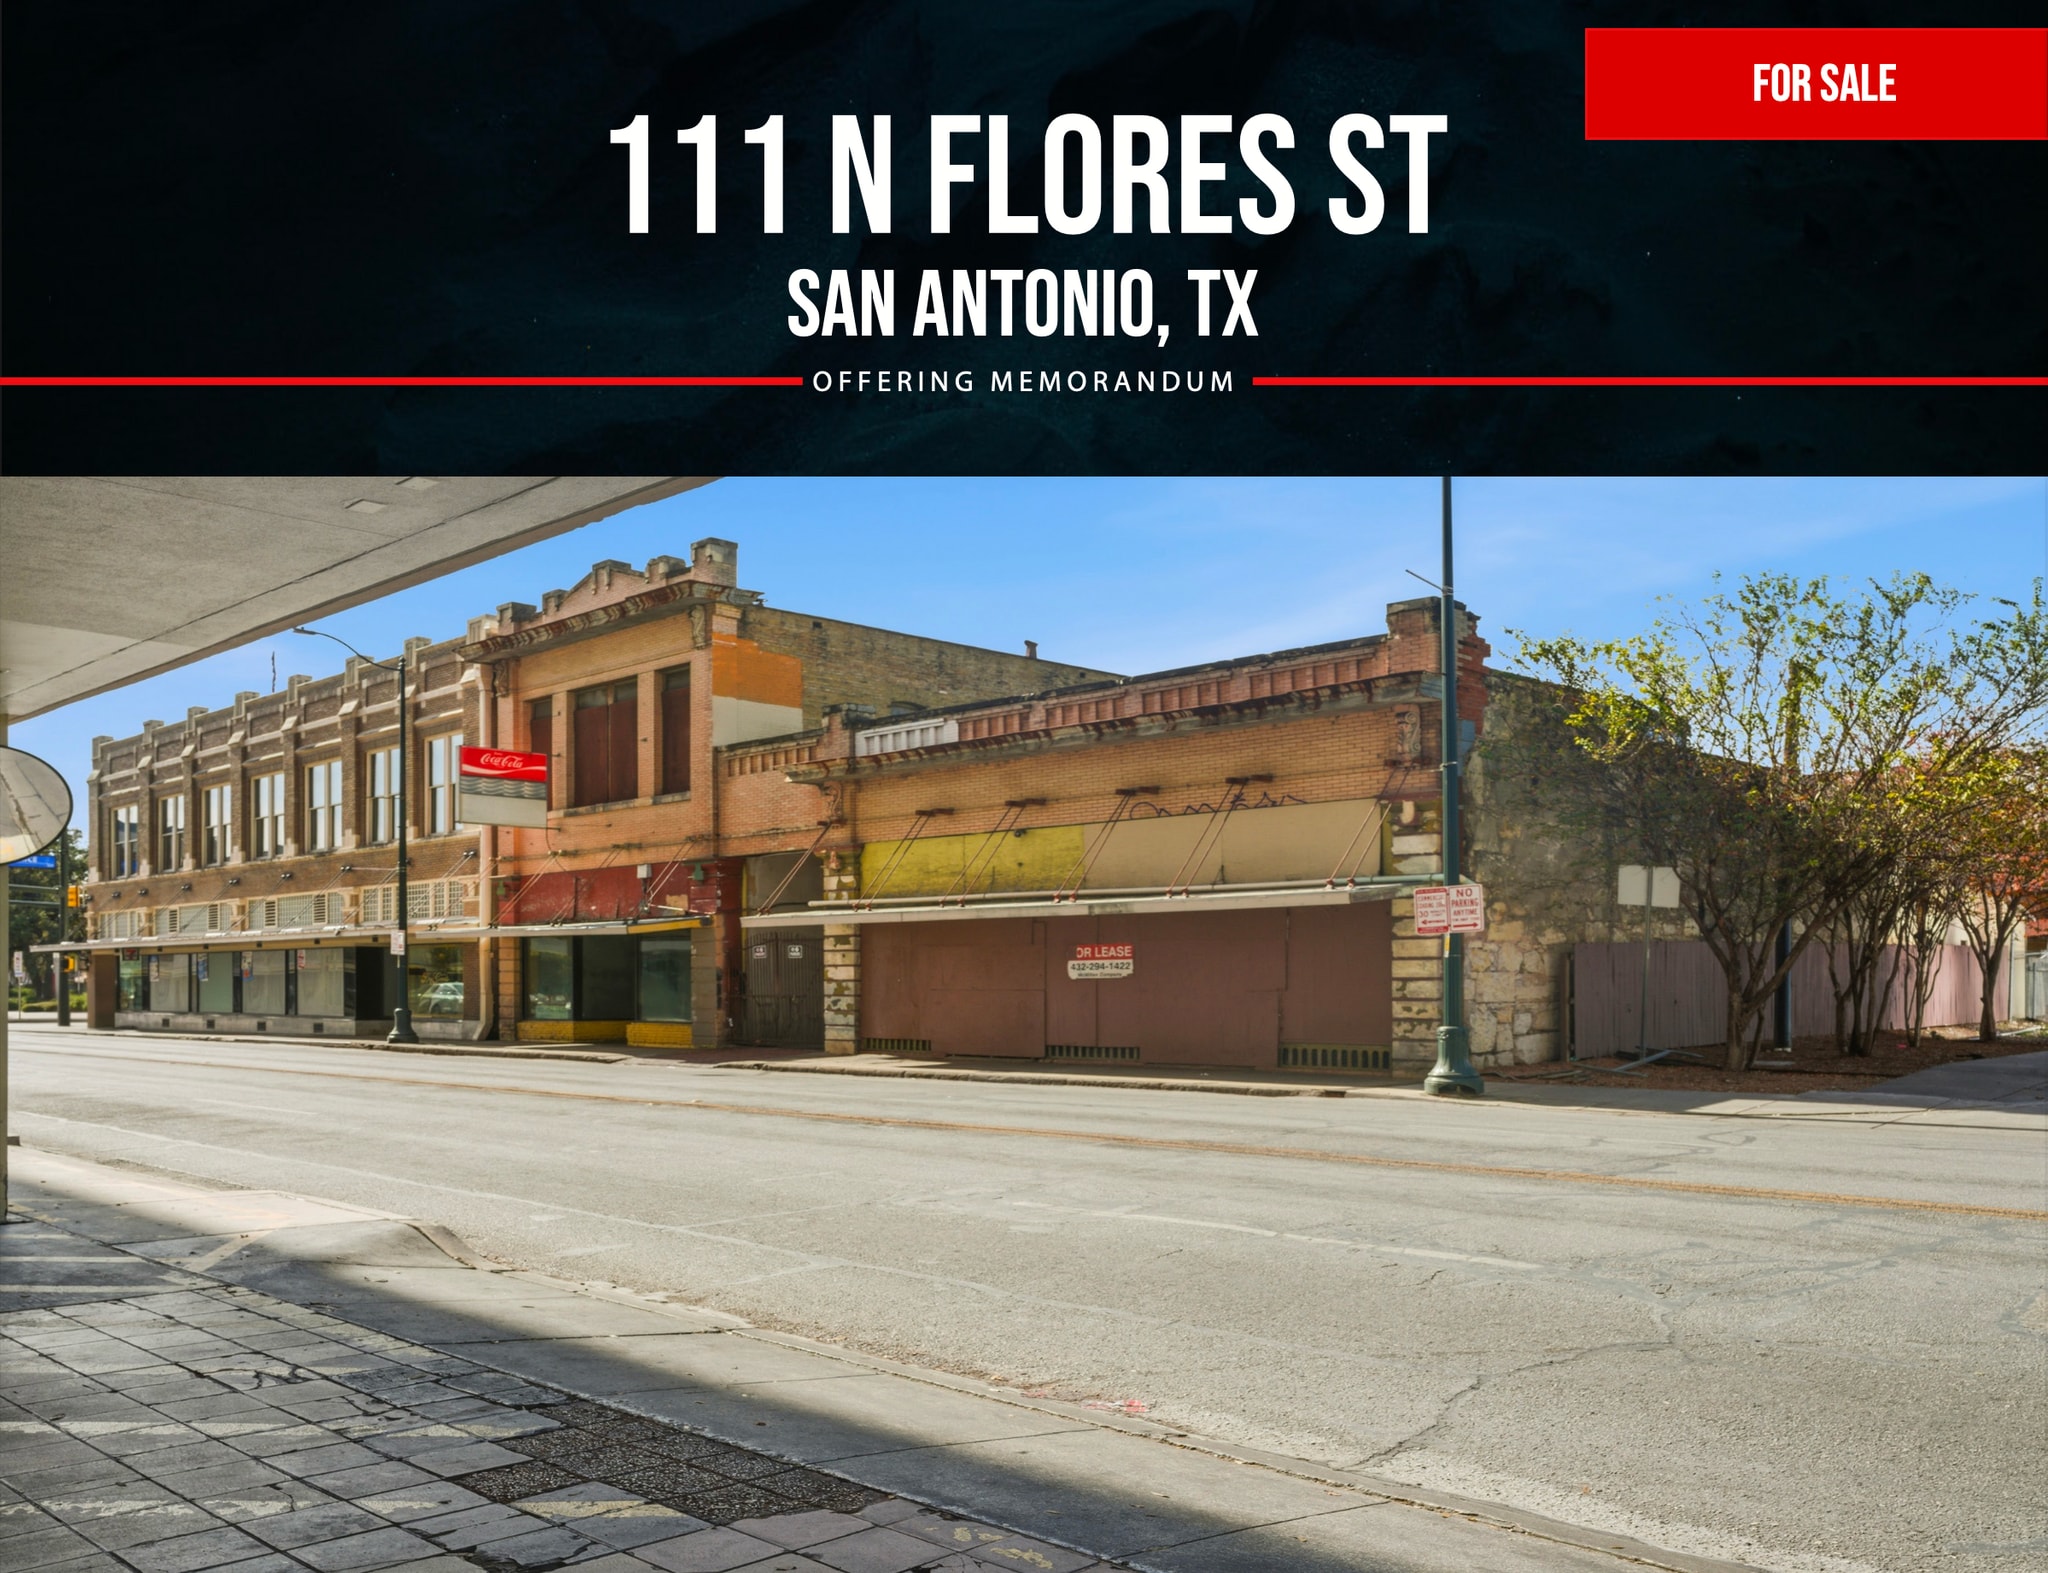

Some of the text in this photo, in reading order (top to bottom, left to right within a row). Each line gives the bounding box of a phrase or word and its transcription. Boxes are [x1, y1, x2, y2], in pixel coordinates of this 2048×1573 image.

[480, 753, 524, 768] Coca-Cola
[1456, 888, 1473, 897] NO
[1451, 898, 1479, 907] PARKING
[1076, 946, 1133, 958] OR LEASE
[1070, 961, 1131, 971] 432-294-1422
